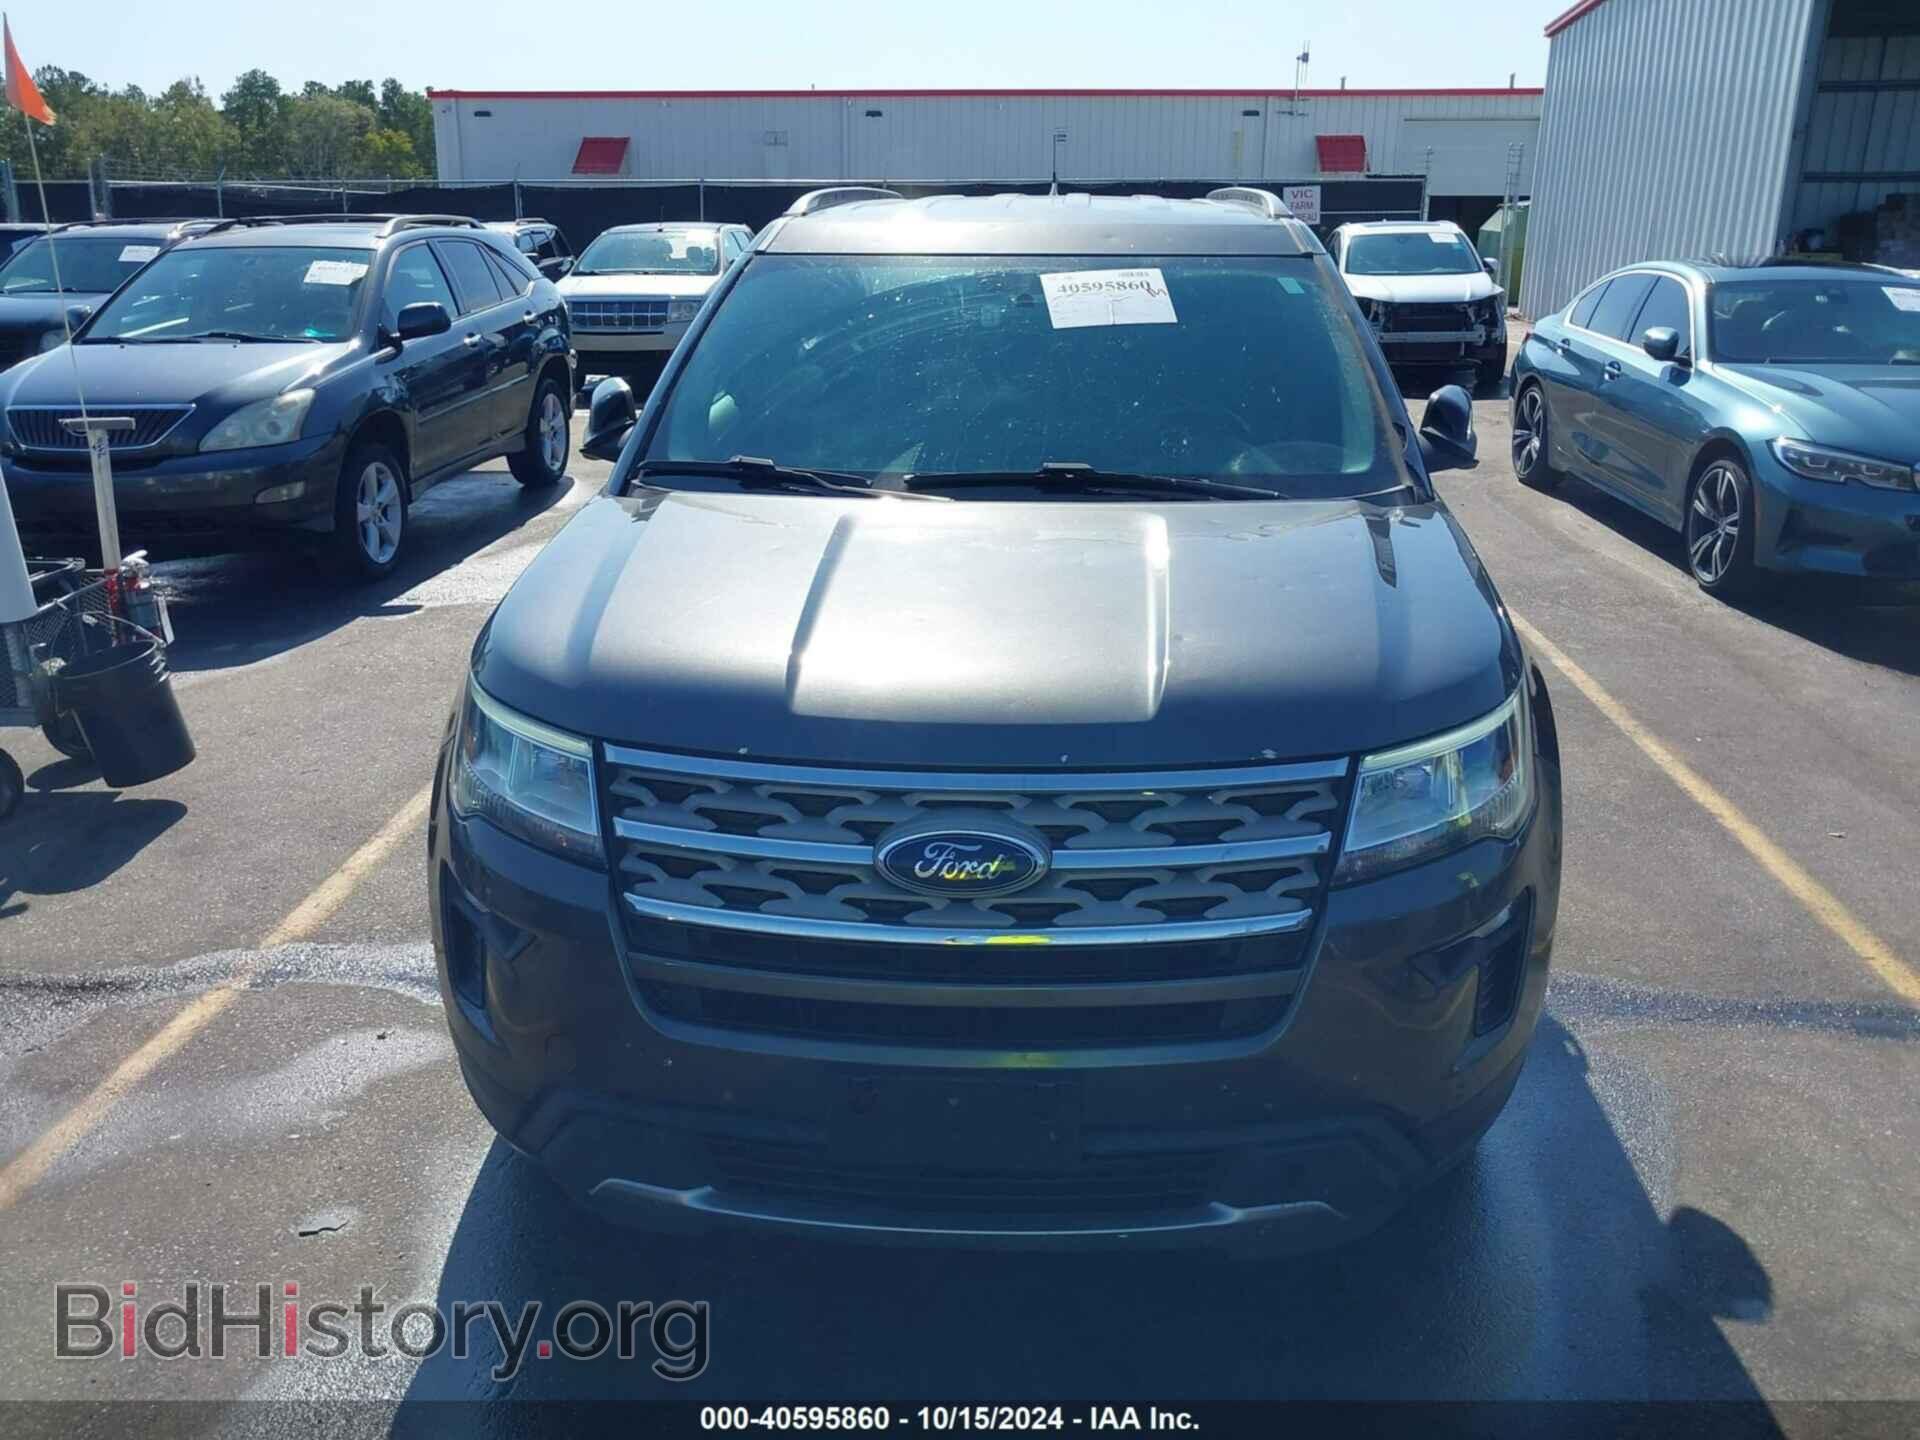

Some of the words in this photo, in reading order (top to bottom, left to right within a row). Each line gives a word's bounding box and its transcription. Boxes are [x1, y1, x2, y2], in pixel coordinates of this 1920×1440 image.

[1291, 189, 1313, 199] VIC
[1057, 280, 1151, 294] 40595860
[914, 841, 1004, 880] Ford
